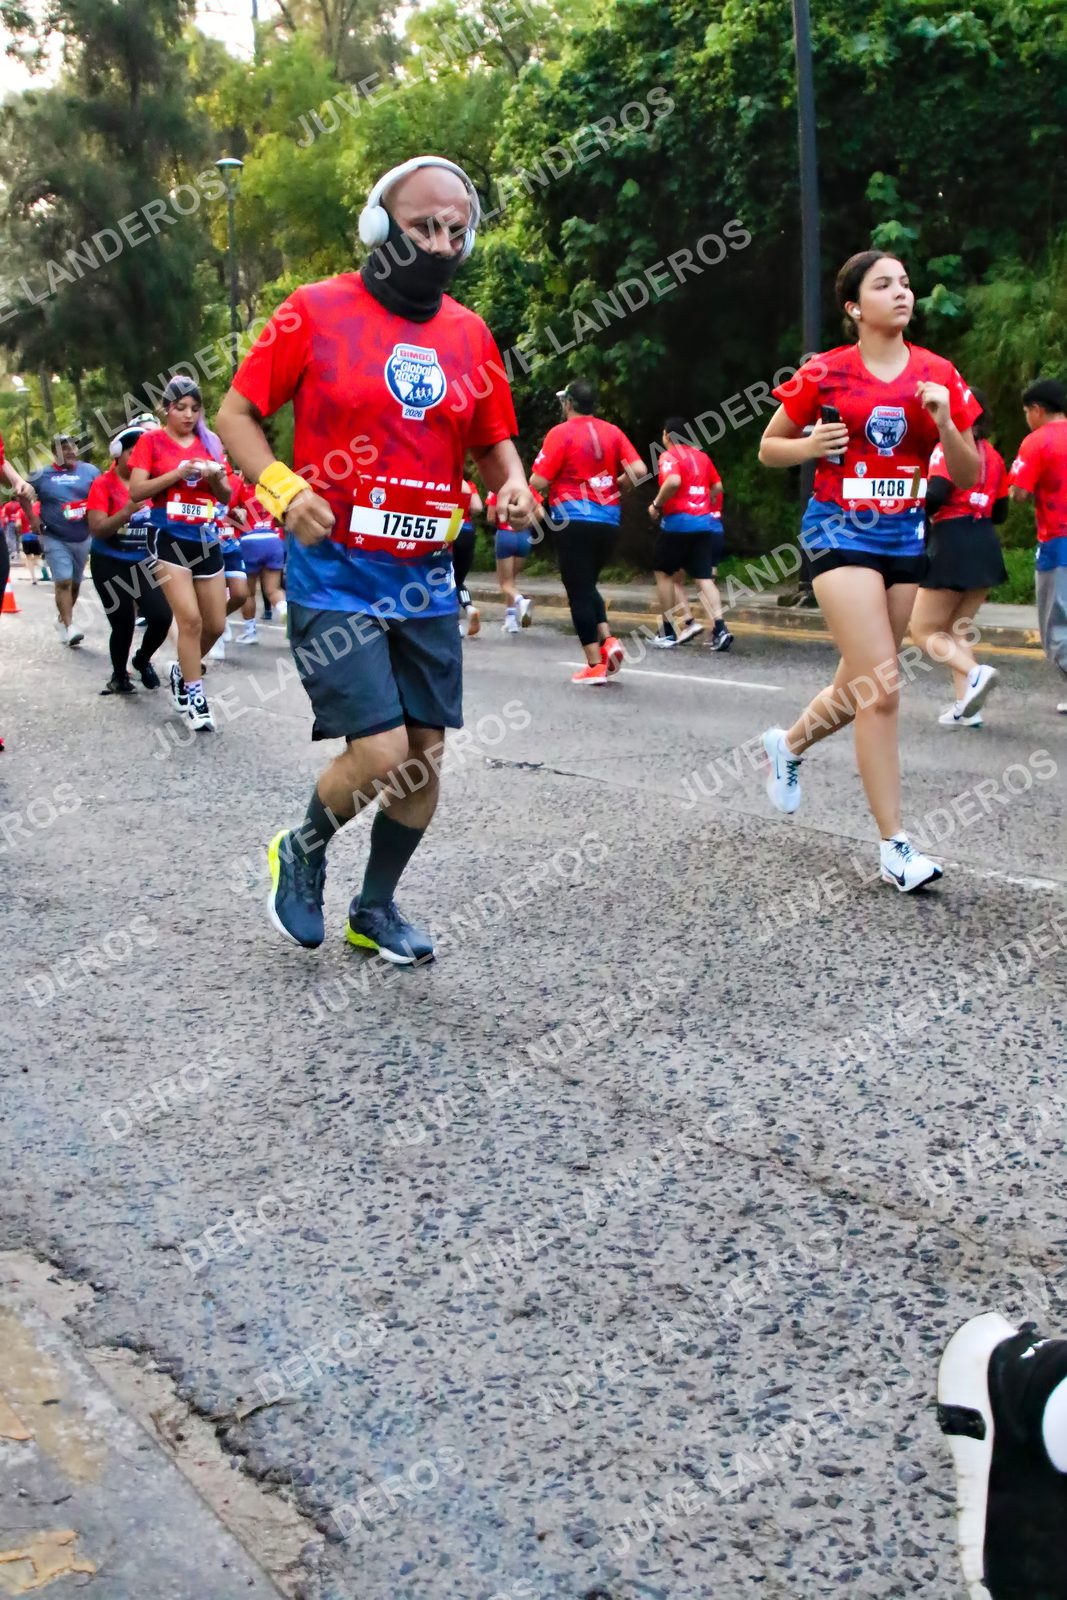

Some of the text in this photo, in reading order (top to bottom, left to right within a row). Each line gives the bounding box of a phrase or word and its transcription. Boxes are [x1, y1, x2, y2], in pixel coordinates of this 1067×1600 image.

[400, 349, 432, 361] BIMBO
[400, 361, 432, 376] Global
[394, 369, 420, 383] Race
[404, 408, 423, 418] 2026
[871, 480, 905, 497] 1408
[181, 505, 201, 516] 3626
[383, 513, 438, 539] 17555
